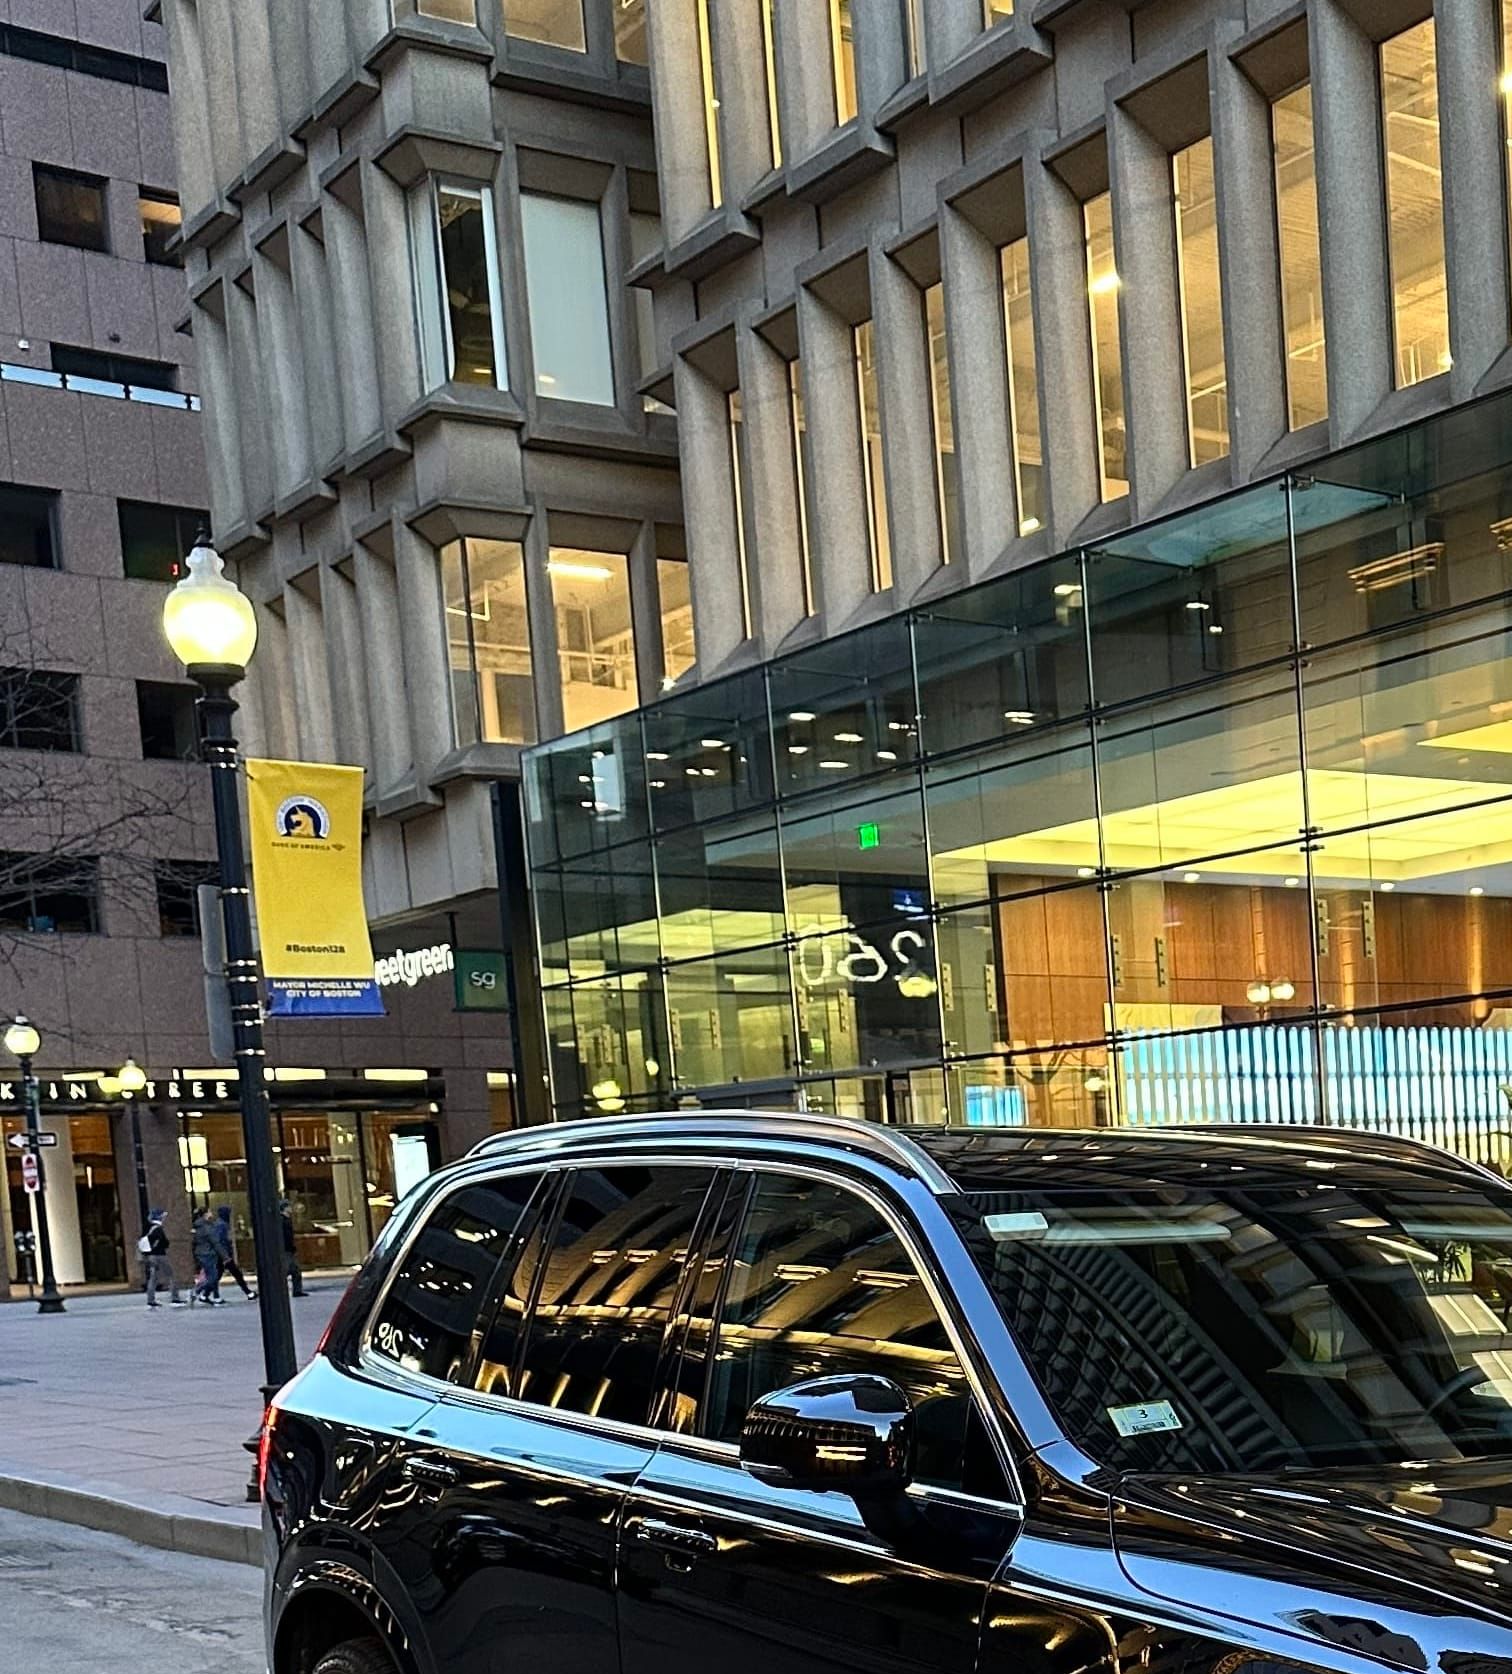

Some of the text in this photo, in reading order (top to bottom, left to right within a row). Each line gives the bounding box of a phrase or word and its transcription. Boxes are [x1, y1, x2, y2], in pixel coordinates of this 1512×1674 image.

[285, 944, 346, 954] #Boston128
[470, 971, 497, 990] sg
[272, 981, 372, 990] MAYOR MICHELLE WU
[285, 990, 362, 998] CITY OF BOSTON
